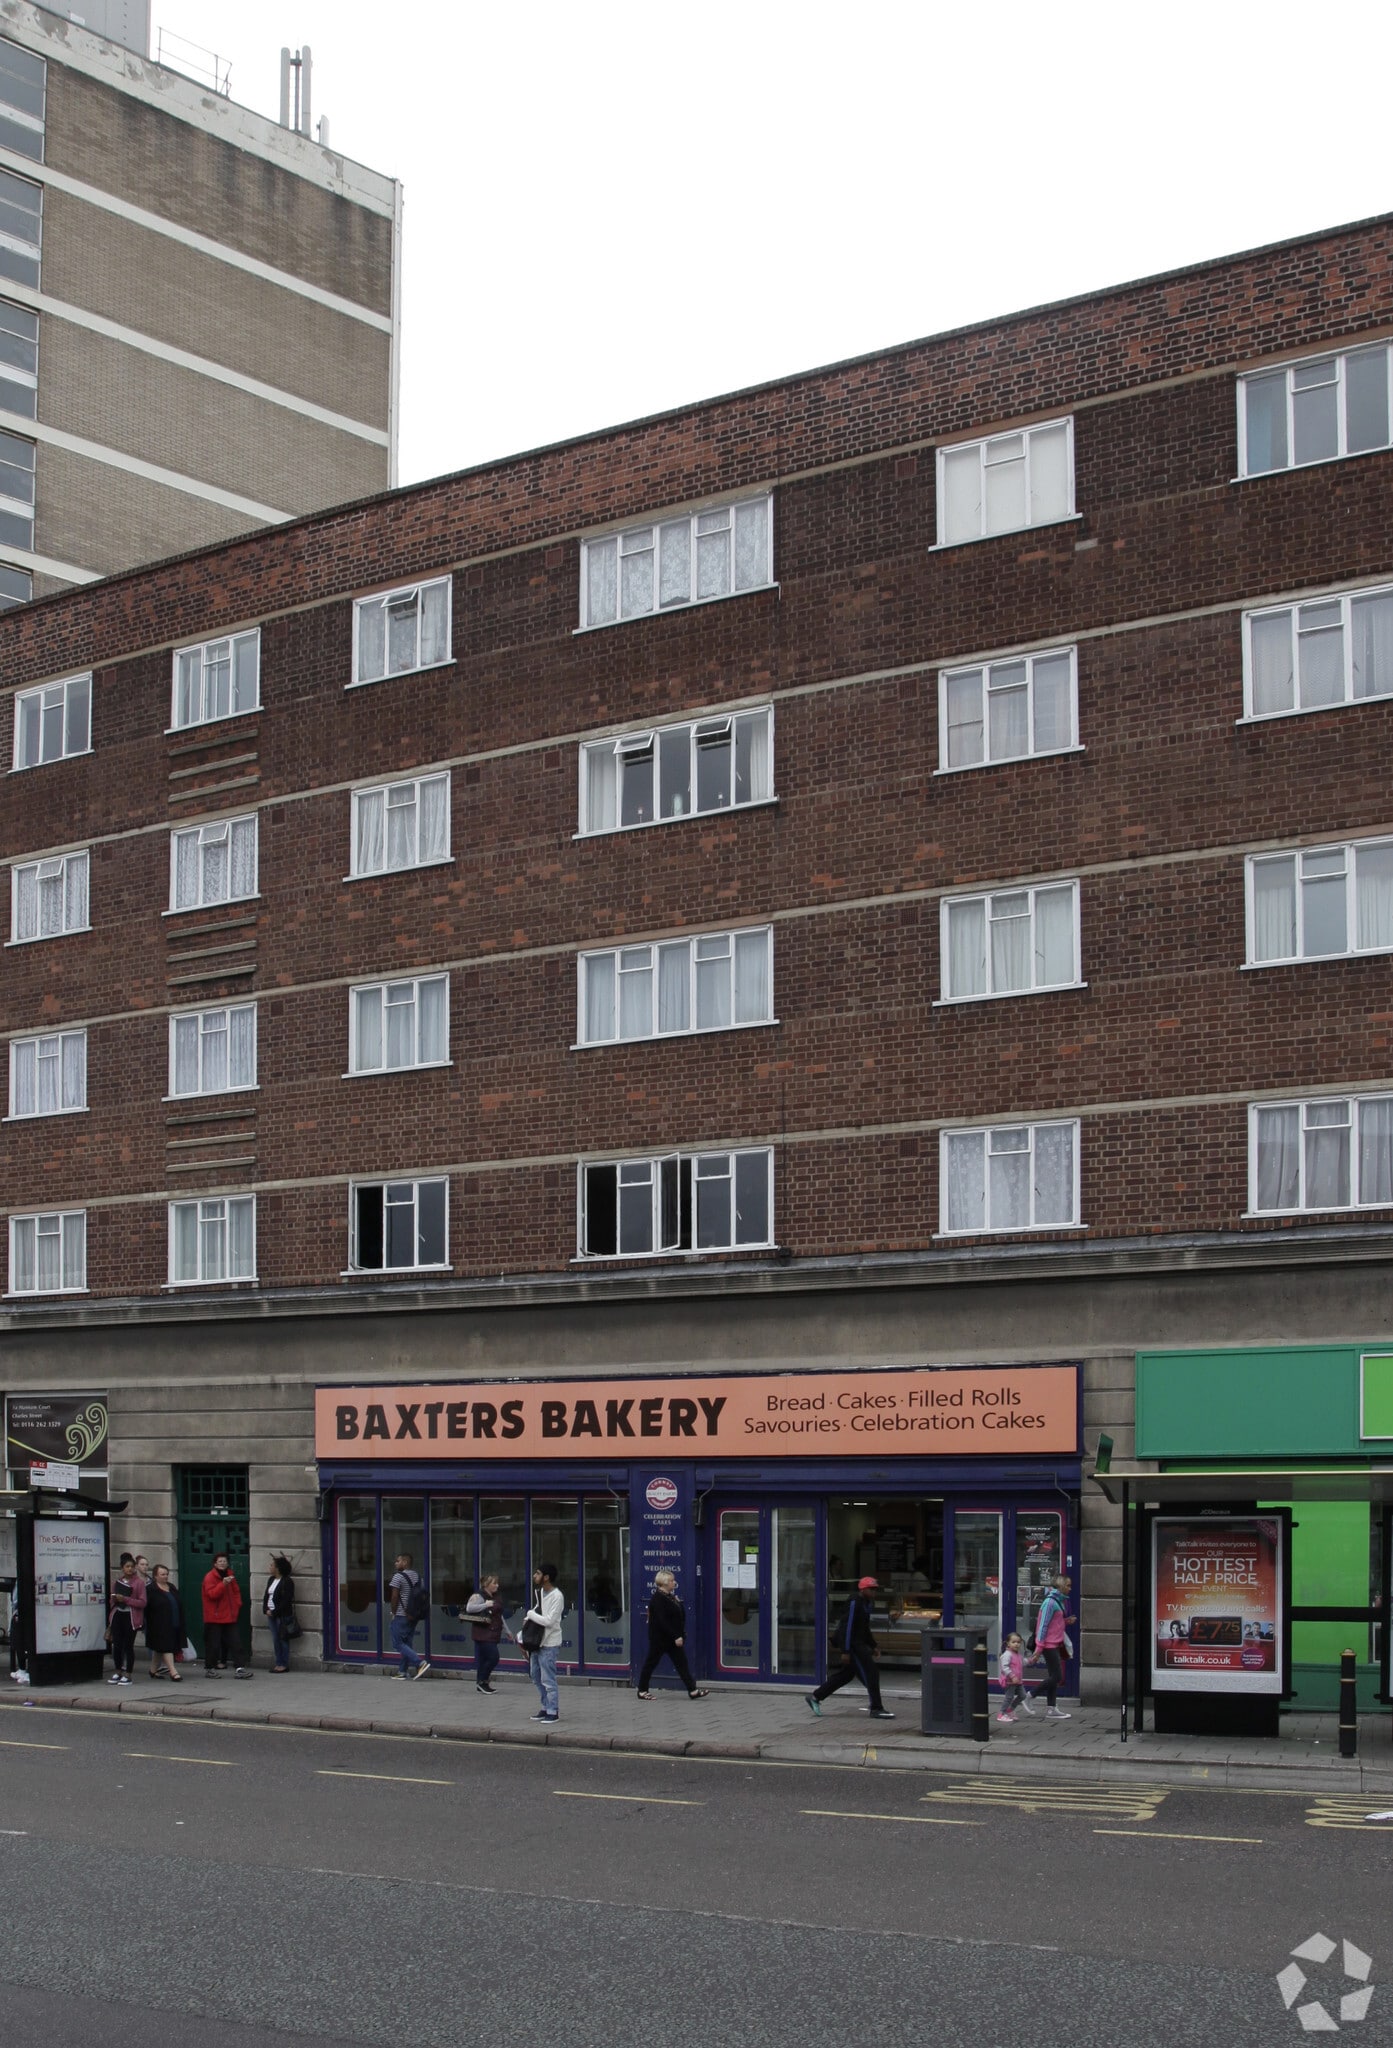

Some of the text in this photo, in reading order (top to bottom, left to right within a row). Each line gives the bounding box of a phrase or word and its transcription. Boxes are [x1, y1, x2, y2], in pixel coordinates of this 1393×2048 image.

[767, 1387, 1022, 1412] Bread Cakes Filled Rolls
[334, 1396, 728, 1441] BAXTERS BAKERY
[744, 1411, 1046, 1434] Savouries Celebration Cakes
[39, 1535, 102, 1545] The Sky Difference
[647, 1534, 678, 1542] NOVELTY
[1219, 1541, 1249, 1549] everyone
[1206, 1549, 1224, 1557] OUR
[1173, 1557, 1258, 1572] HOTTEST
[1173, 1572, 1258, 1585] HALF PRICE
[61, 1623, 81, 1639] sky
[1173, 1655, 1232, 1666] talktalk.co.uk
